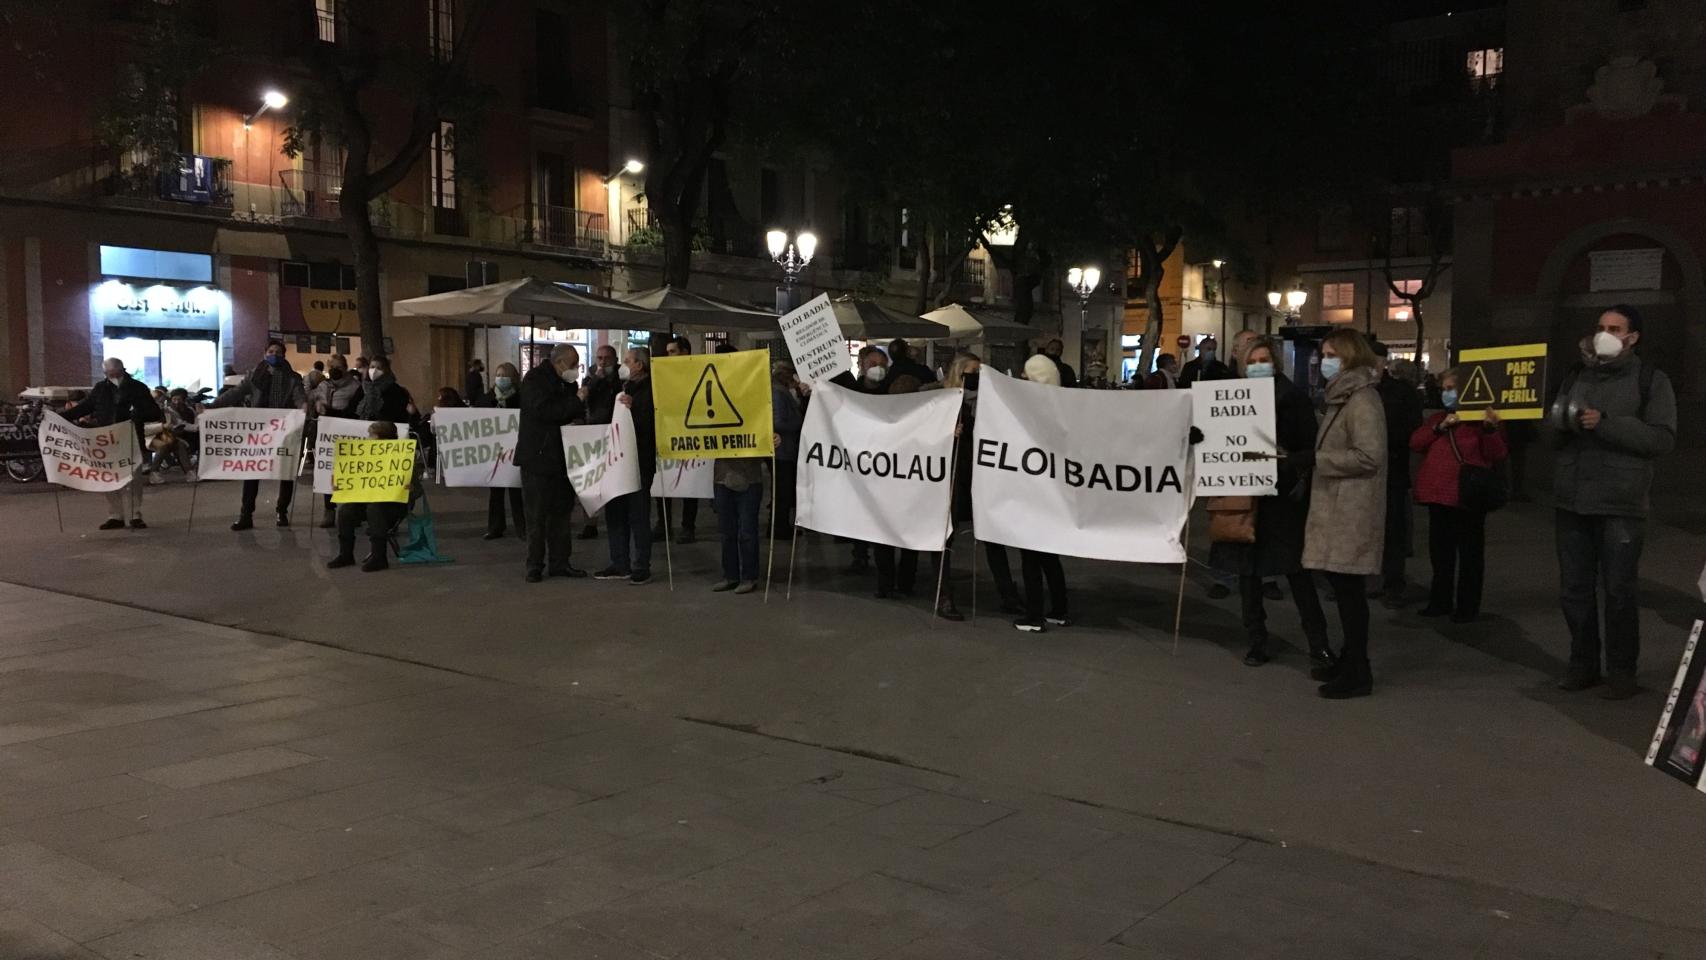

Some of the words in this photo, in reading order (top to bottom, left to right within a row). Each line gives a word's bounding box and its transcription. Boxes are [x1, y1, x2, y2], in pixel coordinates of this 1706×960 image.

[310, 299, 358, 311] curub
[781, 315, 802, 331] ELOI
[803, 300, 830, 320] BADIA
[796, 334, 843, 366] DESTRUINT
[807, 350, 837, 370] ESPAIS
[809, 361, 838, 380] VERDS
[1506, 360, 1536, 376] PARC
[1512, 376, 1527, 389] EN
[1215, 388, 1251, 401] ELOI
[1501, 389, 1538, 403] PERILL
[1210, 404, 1257, 418] BADIA
[205, 421, 265, 431] INSTITUT
[436, 413, 519, 445] RAMBLA
[205, 433, 244, 444] PERÒ
[247, 433, 273, 445] NO
[670, 436, 700, 451] PARC
[703, 435, 718, 450] EN
[721, 433, 757, 449] PERILL
[1225, 435, 1248, 447] NO
[205, 447, 274, 457] DESTRUINT
[276, 447, 294, 457] EL
[338, 442, 365, 456] ELS
[370, 441, 415, 455] ESPAIS
[119, 458, 137, 468] EL
[806, 442, 854, 473] ADA
[856, 450, 946, 482] COLAU
[1202, 451, 1269, 464] ESCO
[58, 463, 120, 483] PARC!
[222, 459, 274, 472] PARC!
[339, 460, 383, 474] VERDS
[389, 458, 412, 472] NO
[977, 438, 1056, 479] ELOI
[1064, 458, 1182, 493] BADIA
[336, 477, 354, 491] ES
[360, 475, 405, 490] TOQEN
[1197, 475, 1225, 487] ALS
[1229, 472, 1274, 487] VEÏNS
